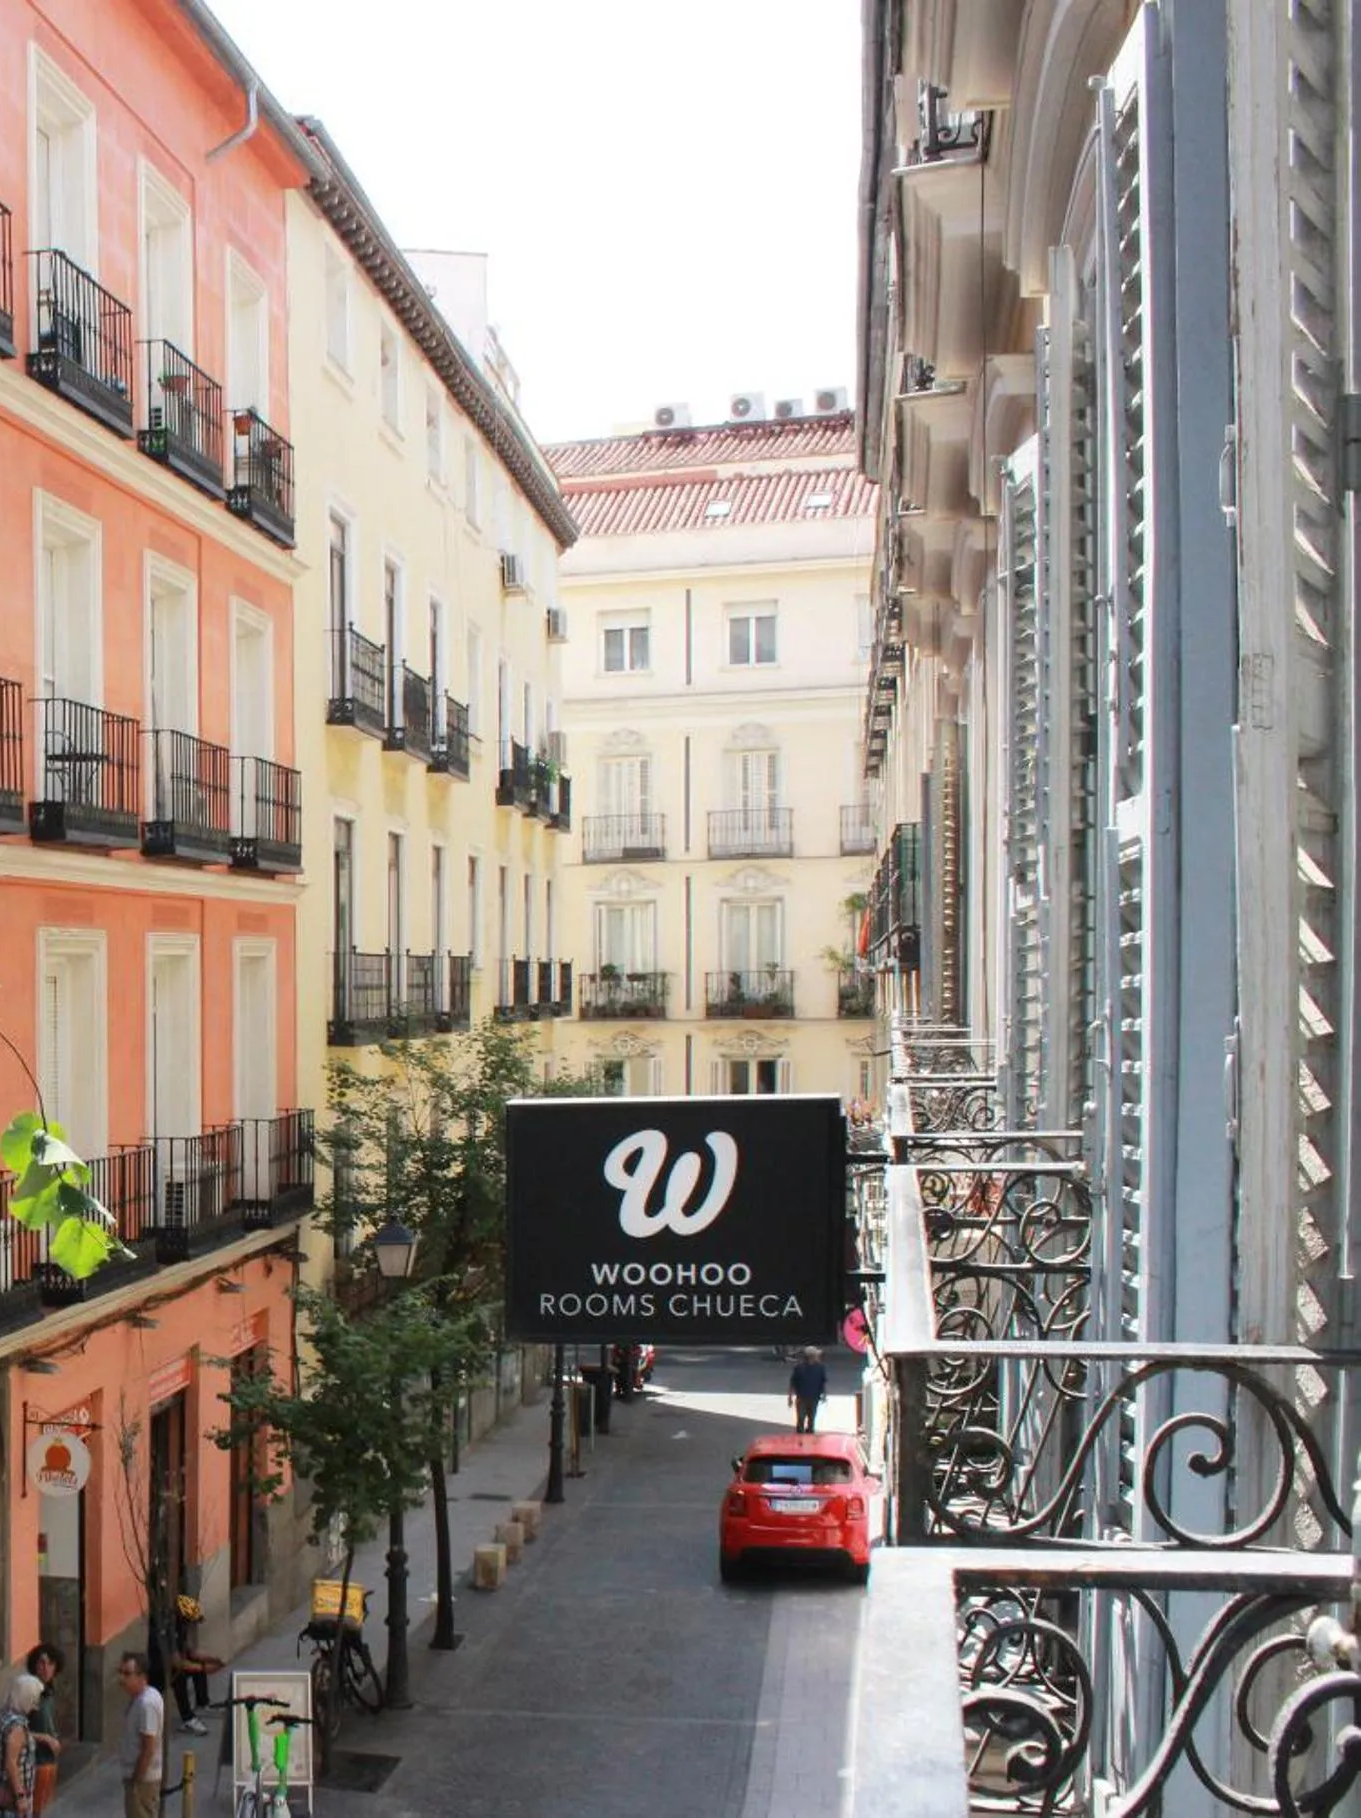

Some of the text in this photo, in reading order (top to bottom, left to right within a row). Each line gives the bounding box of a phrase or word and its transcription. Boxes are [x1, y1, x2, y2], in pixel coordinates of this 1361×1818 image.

[591, 1263, 752, 1286] WOOHOO
[540, 1294, 804, 1318] ROOMS CHUECA
